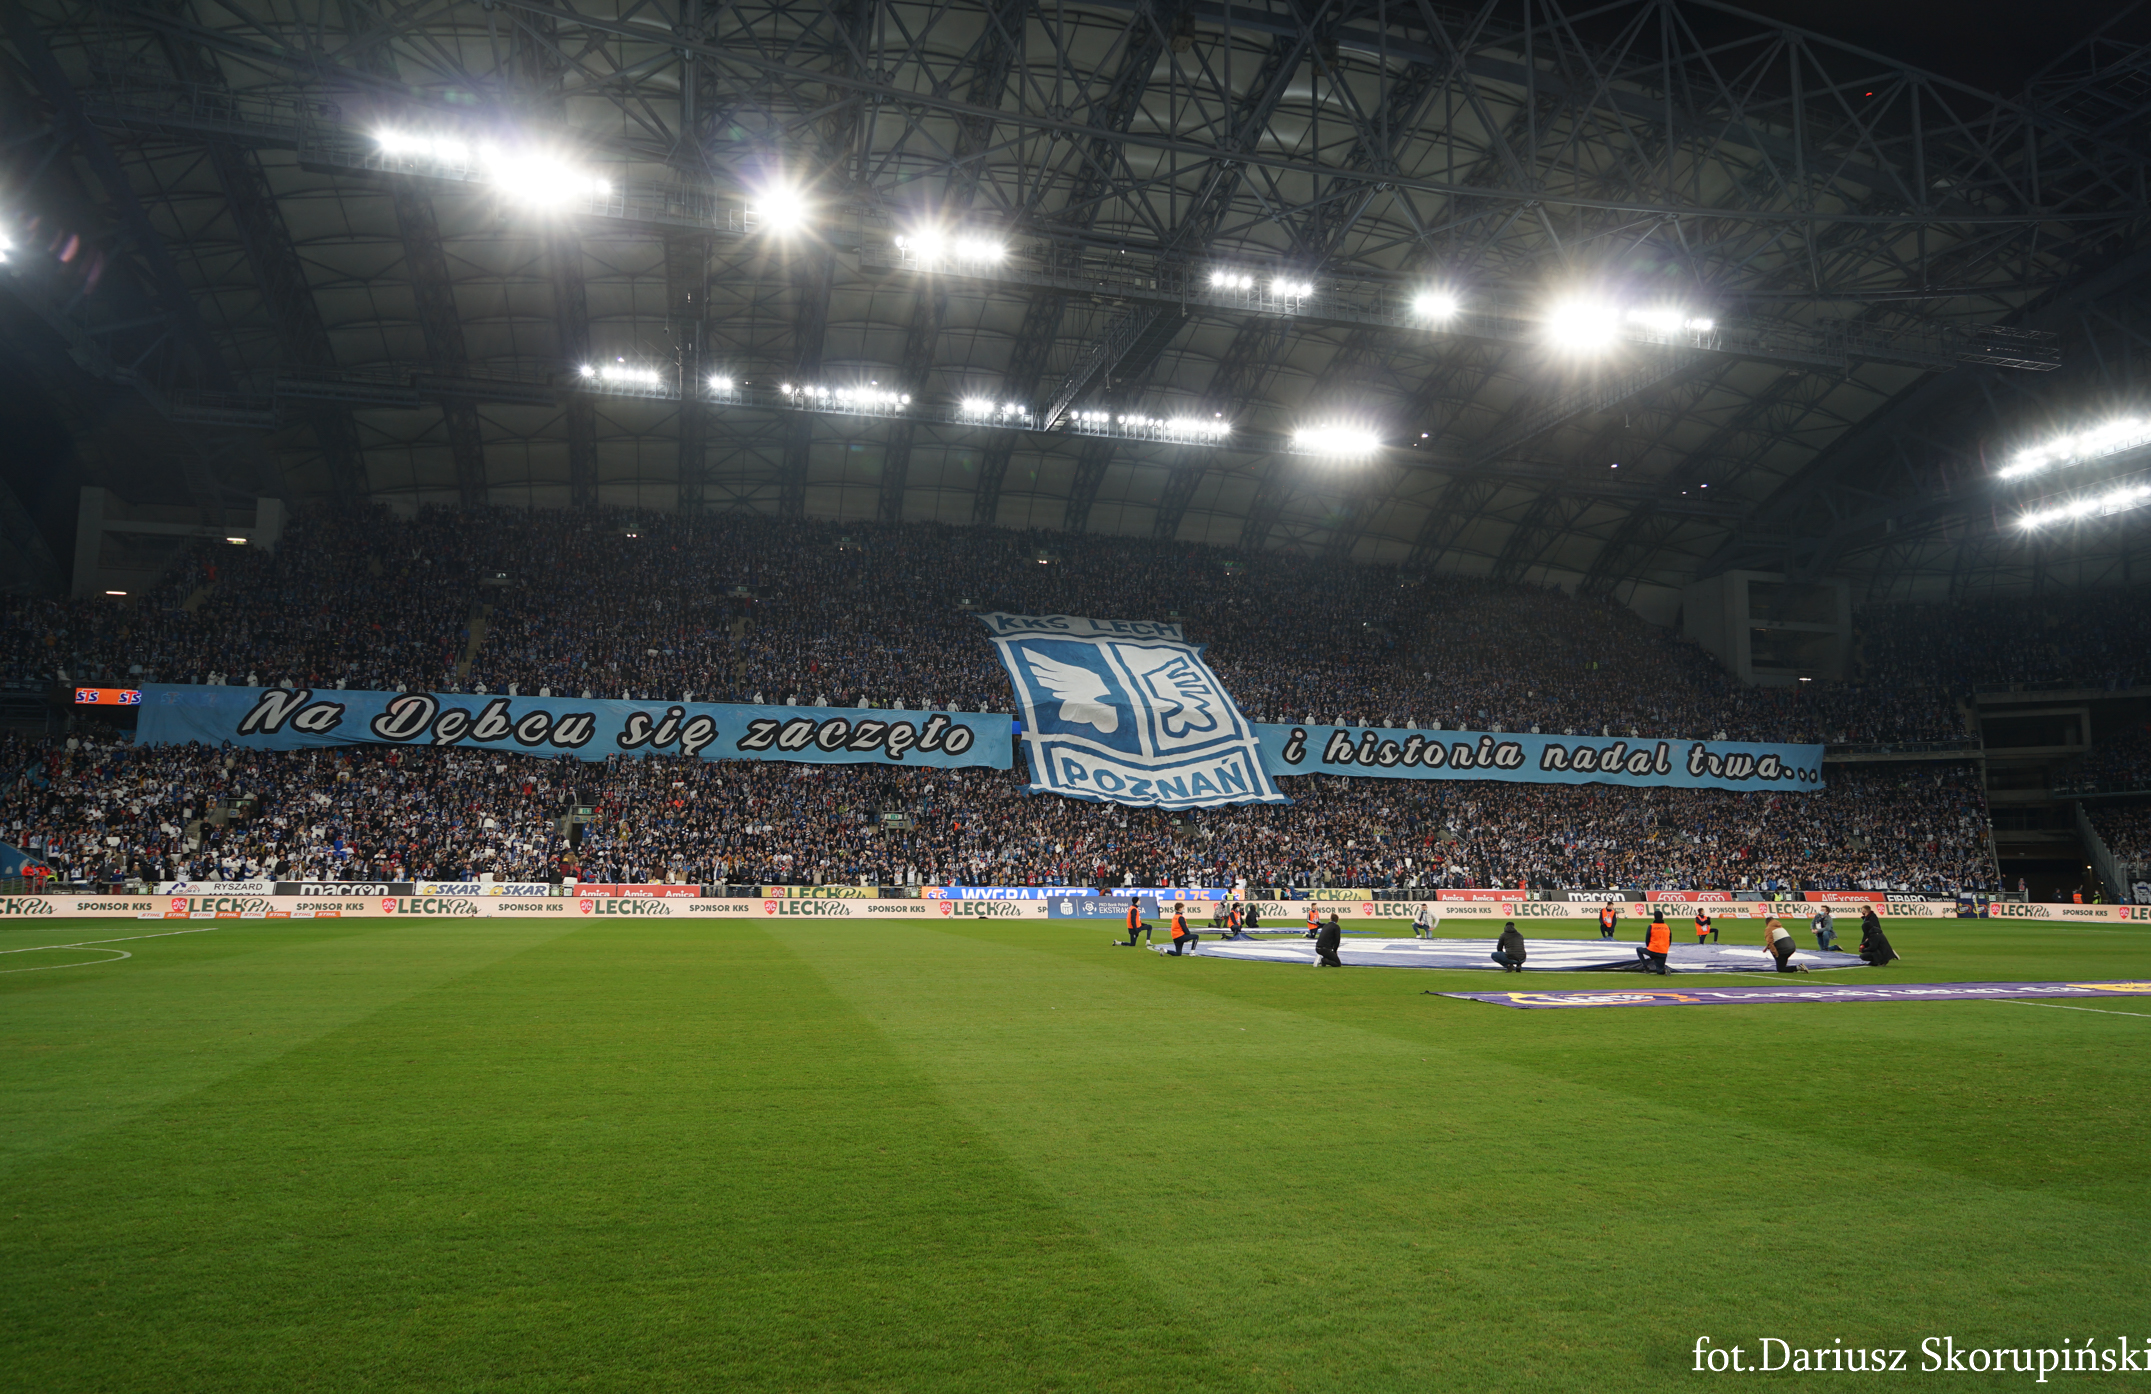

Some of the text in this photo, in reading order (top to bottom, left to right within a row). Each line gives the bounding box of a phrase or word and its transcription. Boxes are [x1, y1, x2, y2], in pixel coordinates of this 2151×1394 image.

[999, 615, 1179, 637] KKS LECH
[76, 689, 99, 704] STS
[118, 690, 141, 704] STS
[239, 690, 345, 735] Na
[371, 694, 595, 746] Dębcu
[618, 707, 718, 756] się
[1283, 728, 1307, 764] i
[1324, 730, 1525, 768] historia
[1541, 742, 1671, 775] nadal
[1061, 756, 1248, 799] POZNAŃ
[300, 884, 389, 896] macron
[580, 889, 610, 897] Amica
[624, 889, 654, 897] Amica
[1568, 892, 1626, 902] macron
[20, 897, 58, 916] Pils
[77, 902, 153, 911] SPONSOR KKS
[189, 898, 245, 912] LECH
[296, 903, 364, 911] SPONSOR KKS
[398, 898, 451, 914] LECH
[498, 903, 564, 911] SPONSOR KKS
[595, 900, 674, 916] LECH Pils
[689, 904, 749, 912] SPONSOR KKS
[779, 900, 853, 916] LECH Pils
[953, 902, 998, 916] LECH
[996, 902, 1024, 917] Pils
[1099, 906, 1146, 914] EKSTRAKSA
[1265, 903, 1290, 917] Pils
[1375, 903, 1409, 917] LECH
[1514, 903, 1571, 917] LECH Pils
[1645, 903, 1680, 916] LECH
[1768, 903, 1801, 914] LECH
[1886, 904, 1917, 916] LECH
[2001, 904, 2033, 917] LECH
